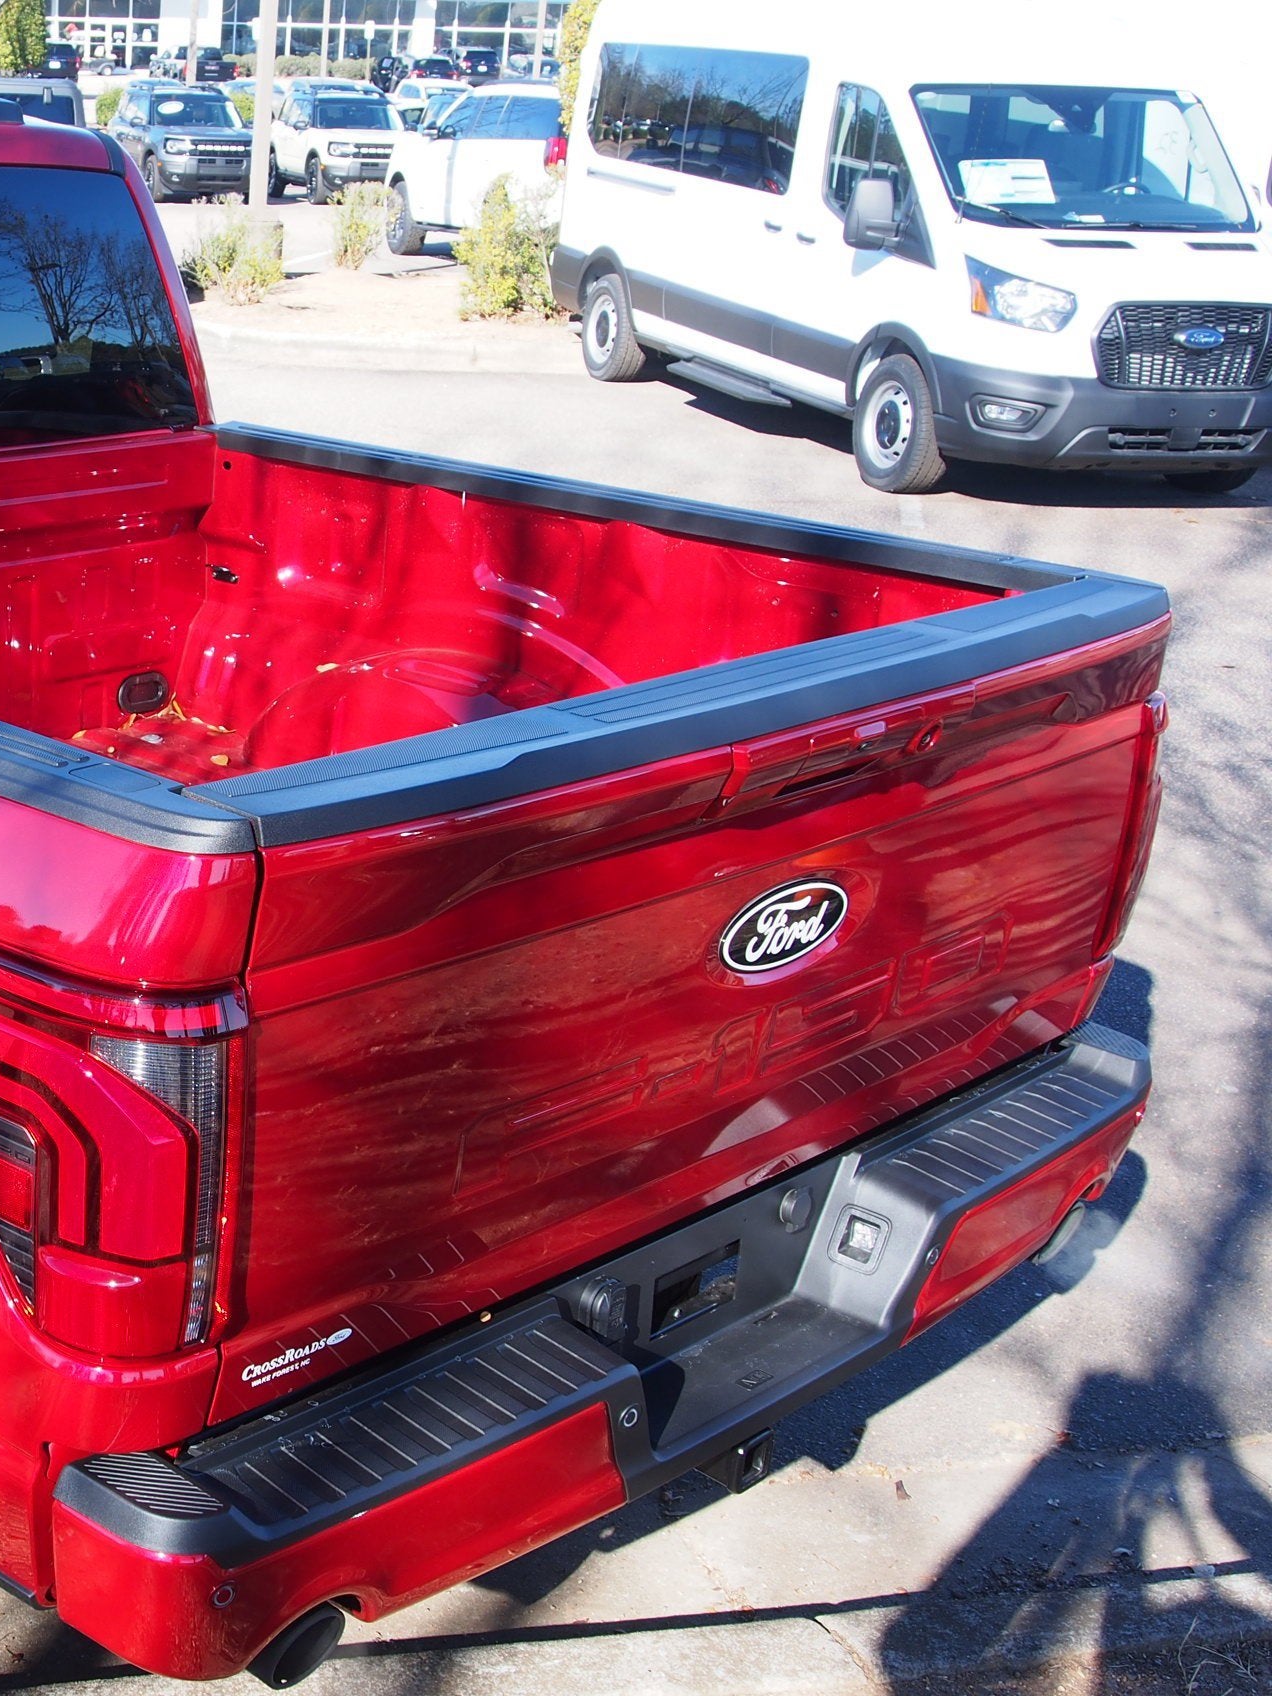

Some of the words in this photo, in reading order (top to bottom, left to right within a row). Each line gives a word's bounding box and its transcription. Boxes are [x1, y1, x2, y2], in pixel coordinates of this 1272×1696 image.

[744, 895, 830, 963] Ford
[251, 1374, 272, 1388] WAKE
[300, 1358, 311, 1368] NC
